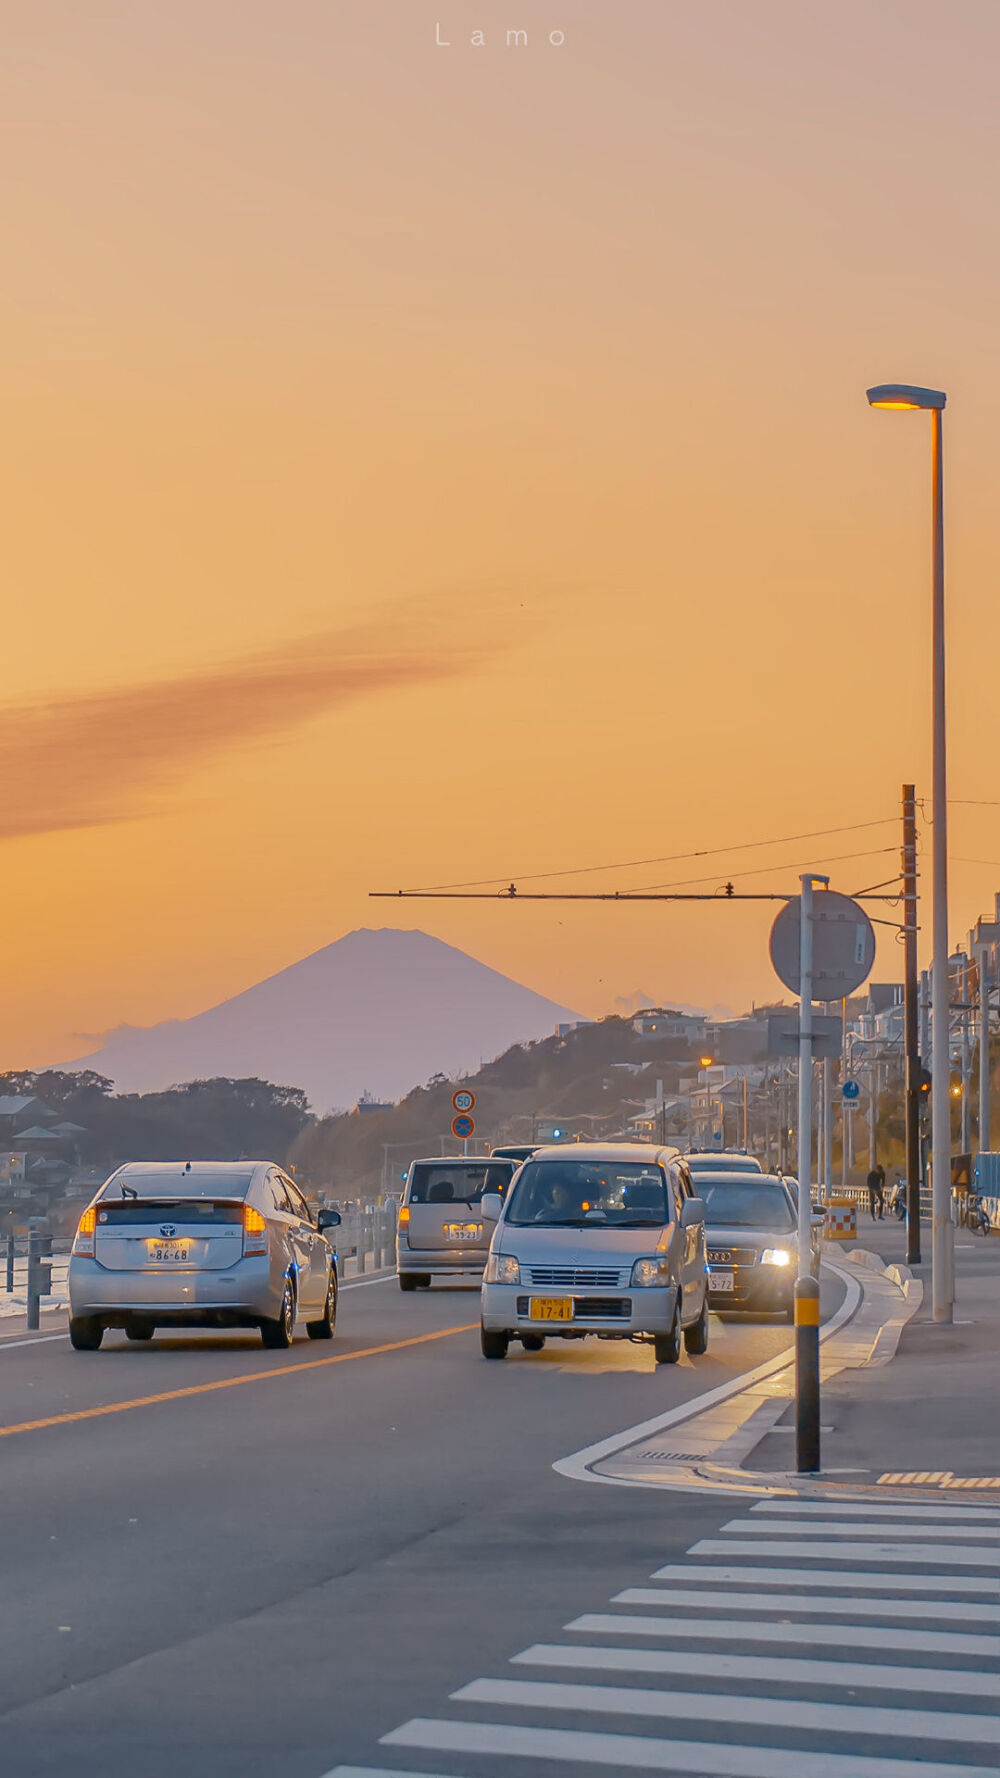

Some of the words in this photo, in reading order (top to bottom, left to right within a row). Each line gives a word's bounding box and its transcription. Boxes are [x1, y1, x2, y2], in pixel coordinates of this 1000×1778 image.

[457, 1095, 471, 1107] 50
[156, 1249, 187, 1260] 86-68
[540, 1306, 570, 1319] 17-41
